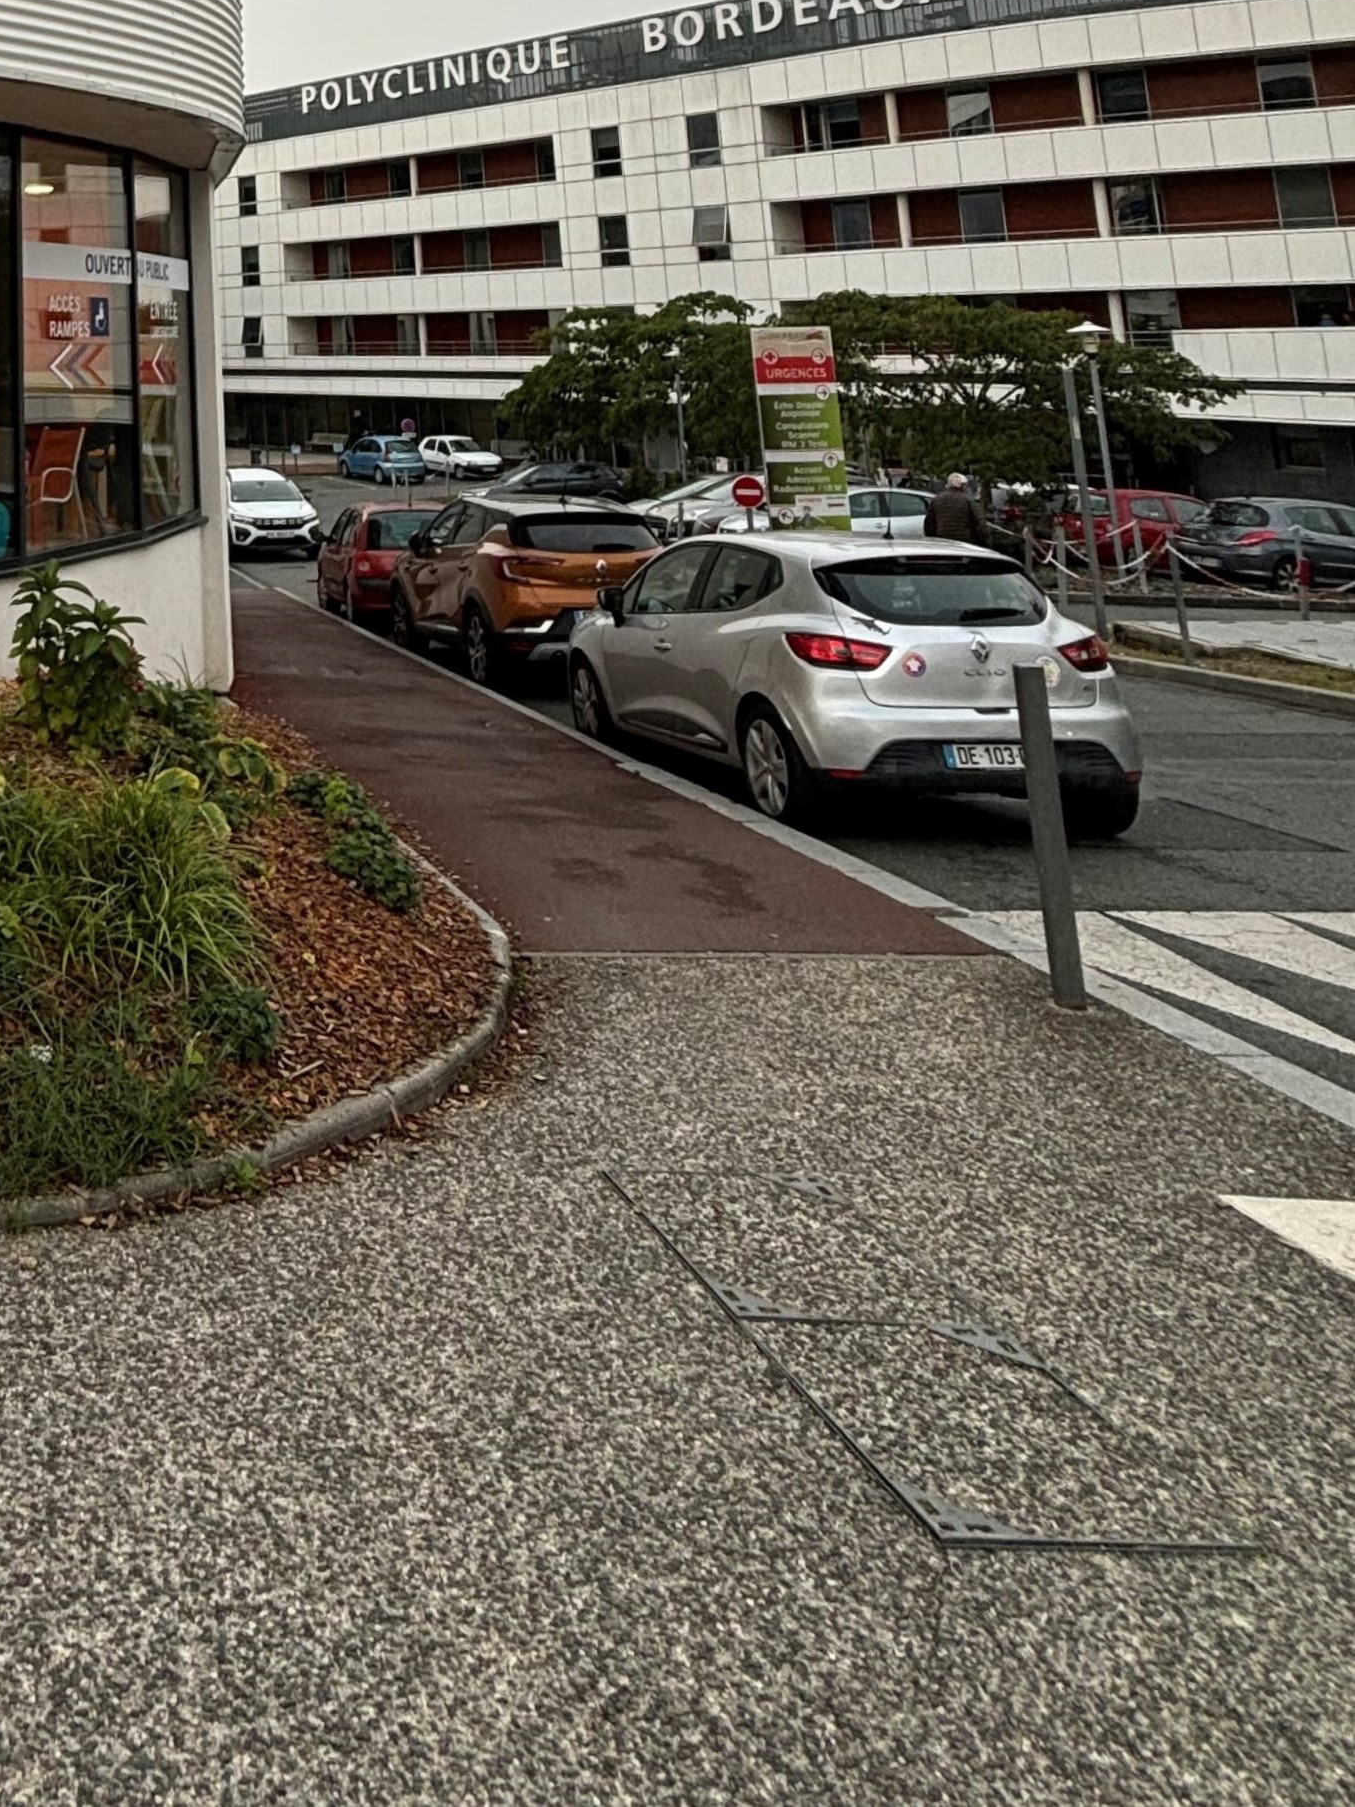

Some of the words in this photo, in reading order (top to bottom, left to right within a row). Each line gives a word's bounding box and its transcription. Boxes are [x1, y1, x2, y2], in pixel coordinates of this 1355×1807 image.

[300, 35, 571, 114] POLYCLINIQUE
[85, 253, 132, 277] OUVERT
[146, 260, 169, 281] PUBLIC
[49, 293, 81, 313] ACCÈS
[49, 321, 90, 338] RAMPES
[766, 367, 827, 379] URGENCES
[964, 669, 1007, 677] CLIO
[957, 746, 1025, 766] DE-103-
